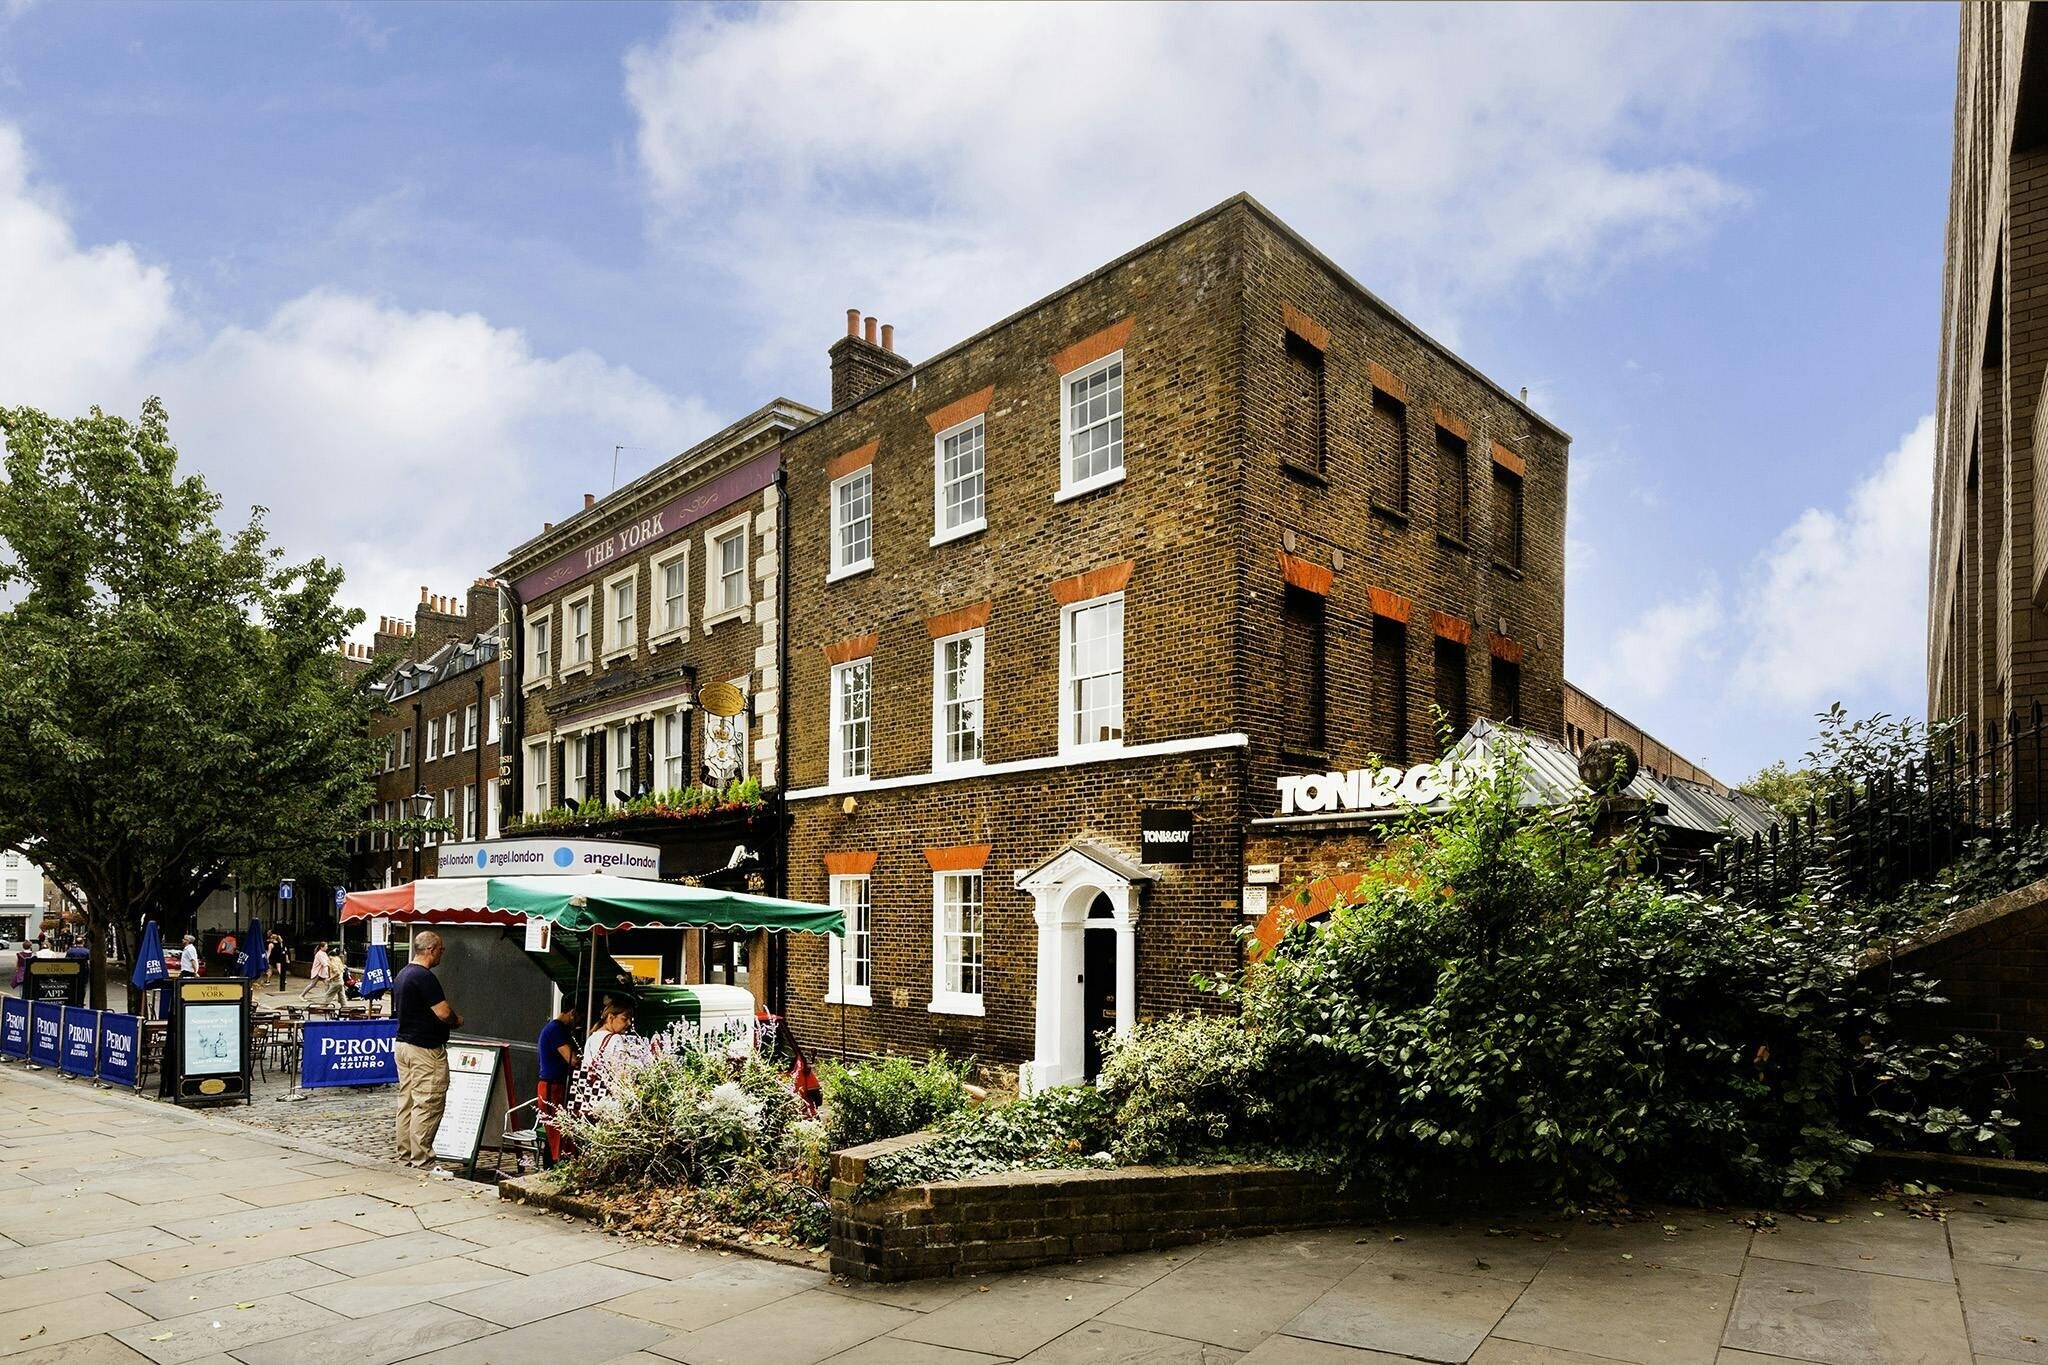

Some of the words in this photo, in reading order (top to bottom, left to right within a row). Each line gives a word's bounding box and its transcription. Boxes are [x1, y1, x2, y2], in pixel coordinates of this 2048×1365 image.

[585, 537, 615, 568] THE
[619, 512, 665, 552] YORK
[1143, 830, 1191, 843] TONI&GUY
[438, 855, 474, 870] gel.london
[490, 851, 544, 867] angel.london
[584, 852, 657, 868] angel.london
[44, 989, 65, 998] APP
[6, 1011, 26, 1031] PERONI
[37, 1017, 58, 1037] PERONI
[68, 1023, 93, 1044] PERONI
[106, 1029, 132, 1052] PERONI
[321, 1037, 396, 1056] PERONI
[331, 1060, 385, 1070] AZZURRO
[341, 1054, 377, 1062] NASTRO
